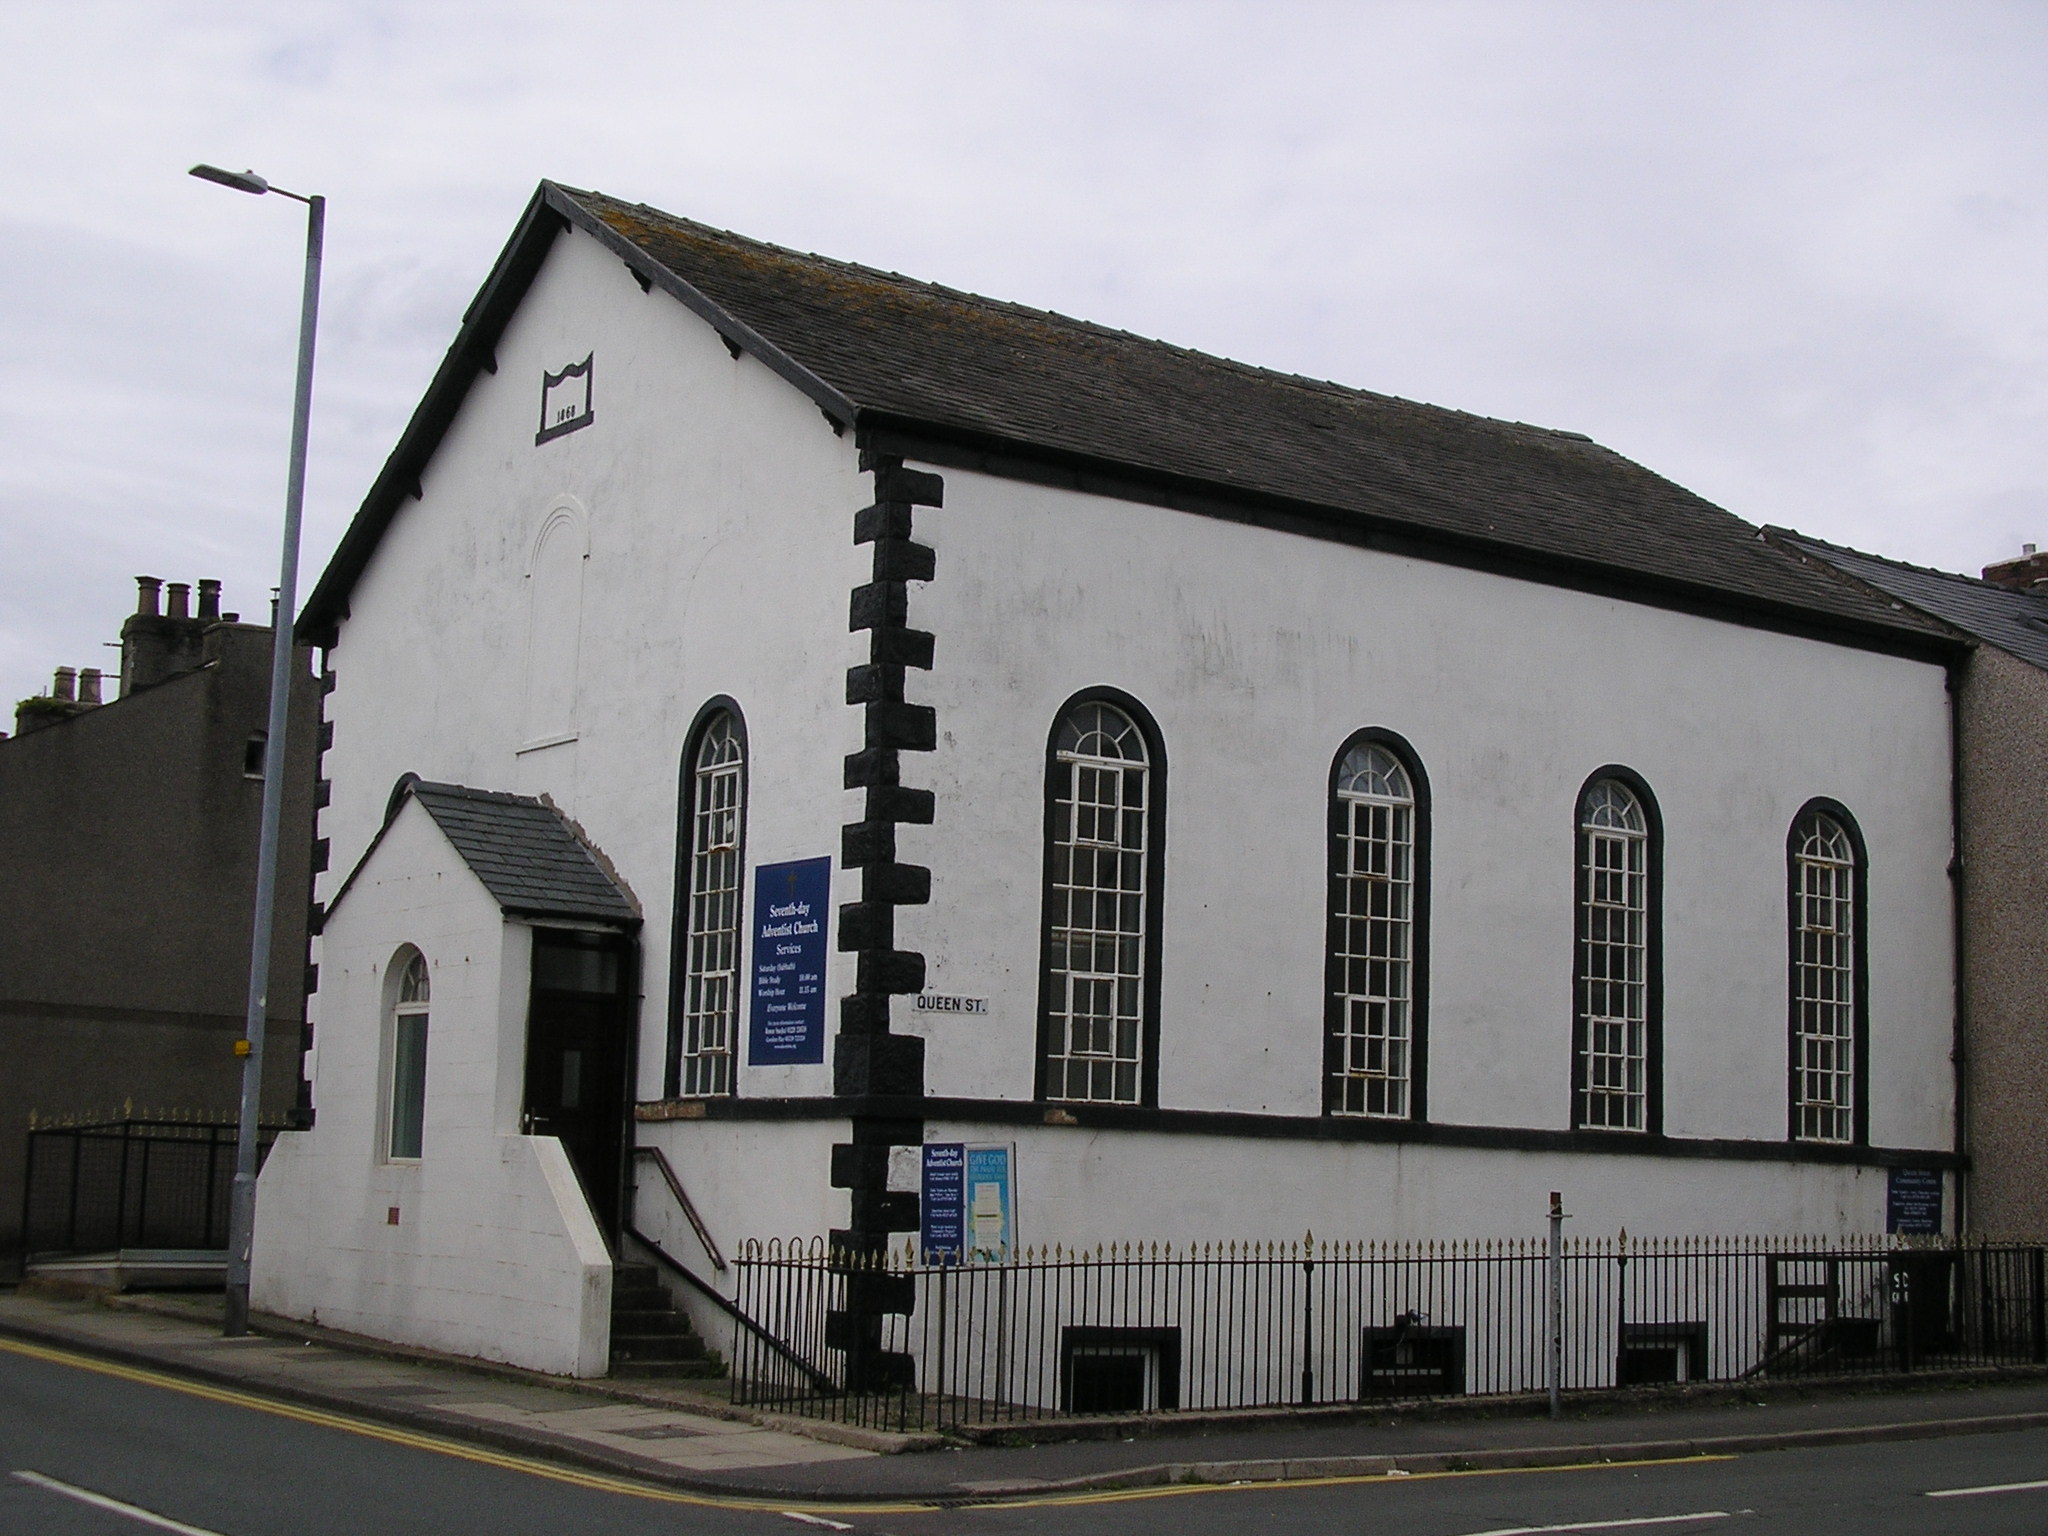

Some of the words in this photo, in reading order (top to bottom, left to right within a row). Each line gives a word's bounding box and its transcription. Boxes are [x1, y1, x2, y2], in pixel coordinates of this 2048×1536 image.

[769, 901, 810, 918] Seventh-day
[761, 923, 793, 938] Adventist
[793, 919, 819, 936] Church
[776, 942, 802, 956] Services
[917, 995, 961, 1011] QUEEN
[965, 998, 986, 1012] ST.
[947, 1158, 963, 1167] Church
